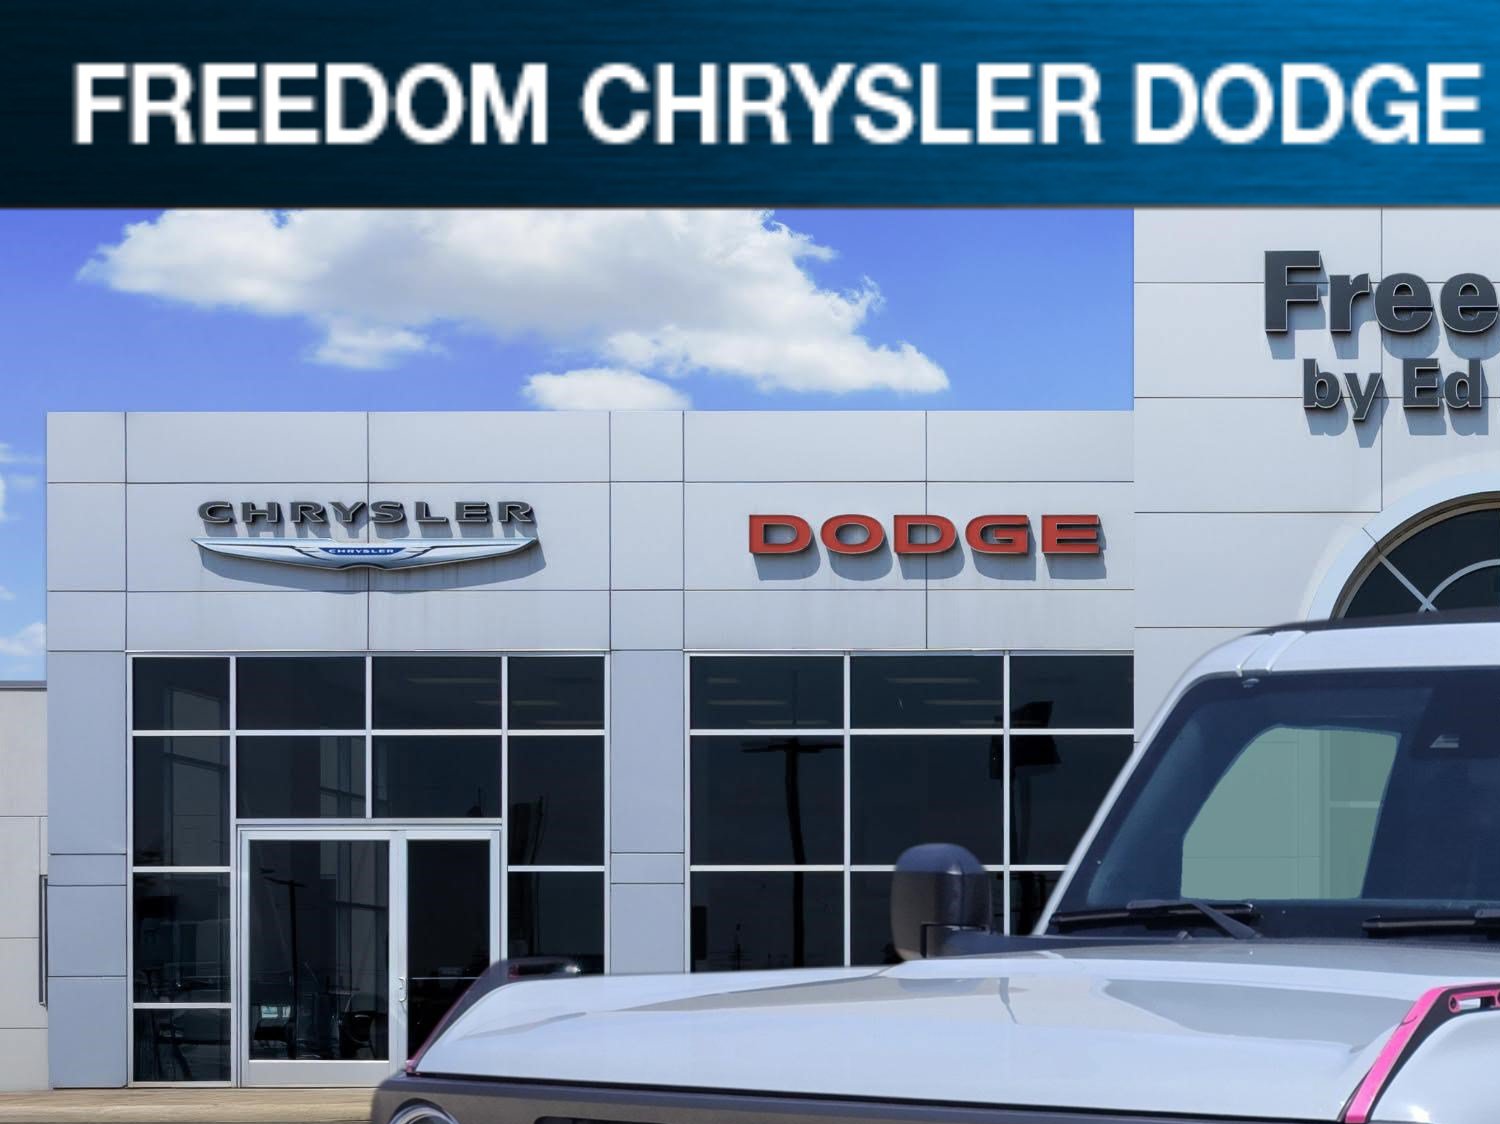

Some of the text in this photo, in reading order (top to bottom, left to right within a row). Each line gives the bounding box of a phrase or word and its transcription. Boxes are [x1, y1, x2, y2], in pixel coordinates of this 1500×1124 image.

[1303, 358, 1383, 421] by
[1402, 358, 1483, 409] Ed
[197, 500, 535, 524] CHRYSLER
[748, 513, 1101, 555] DODGE
